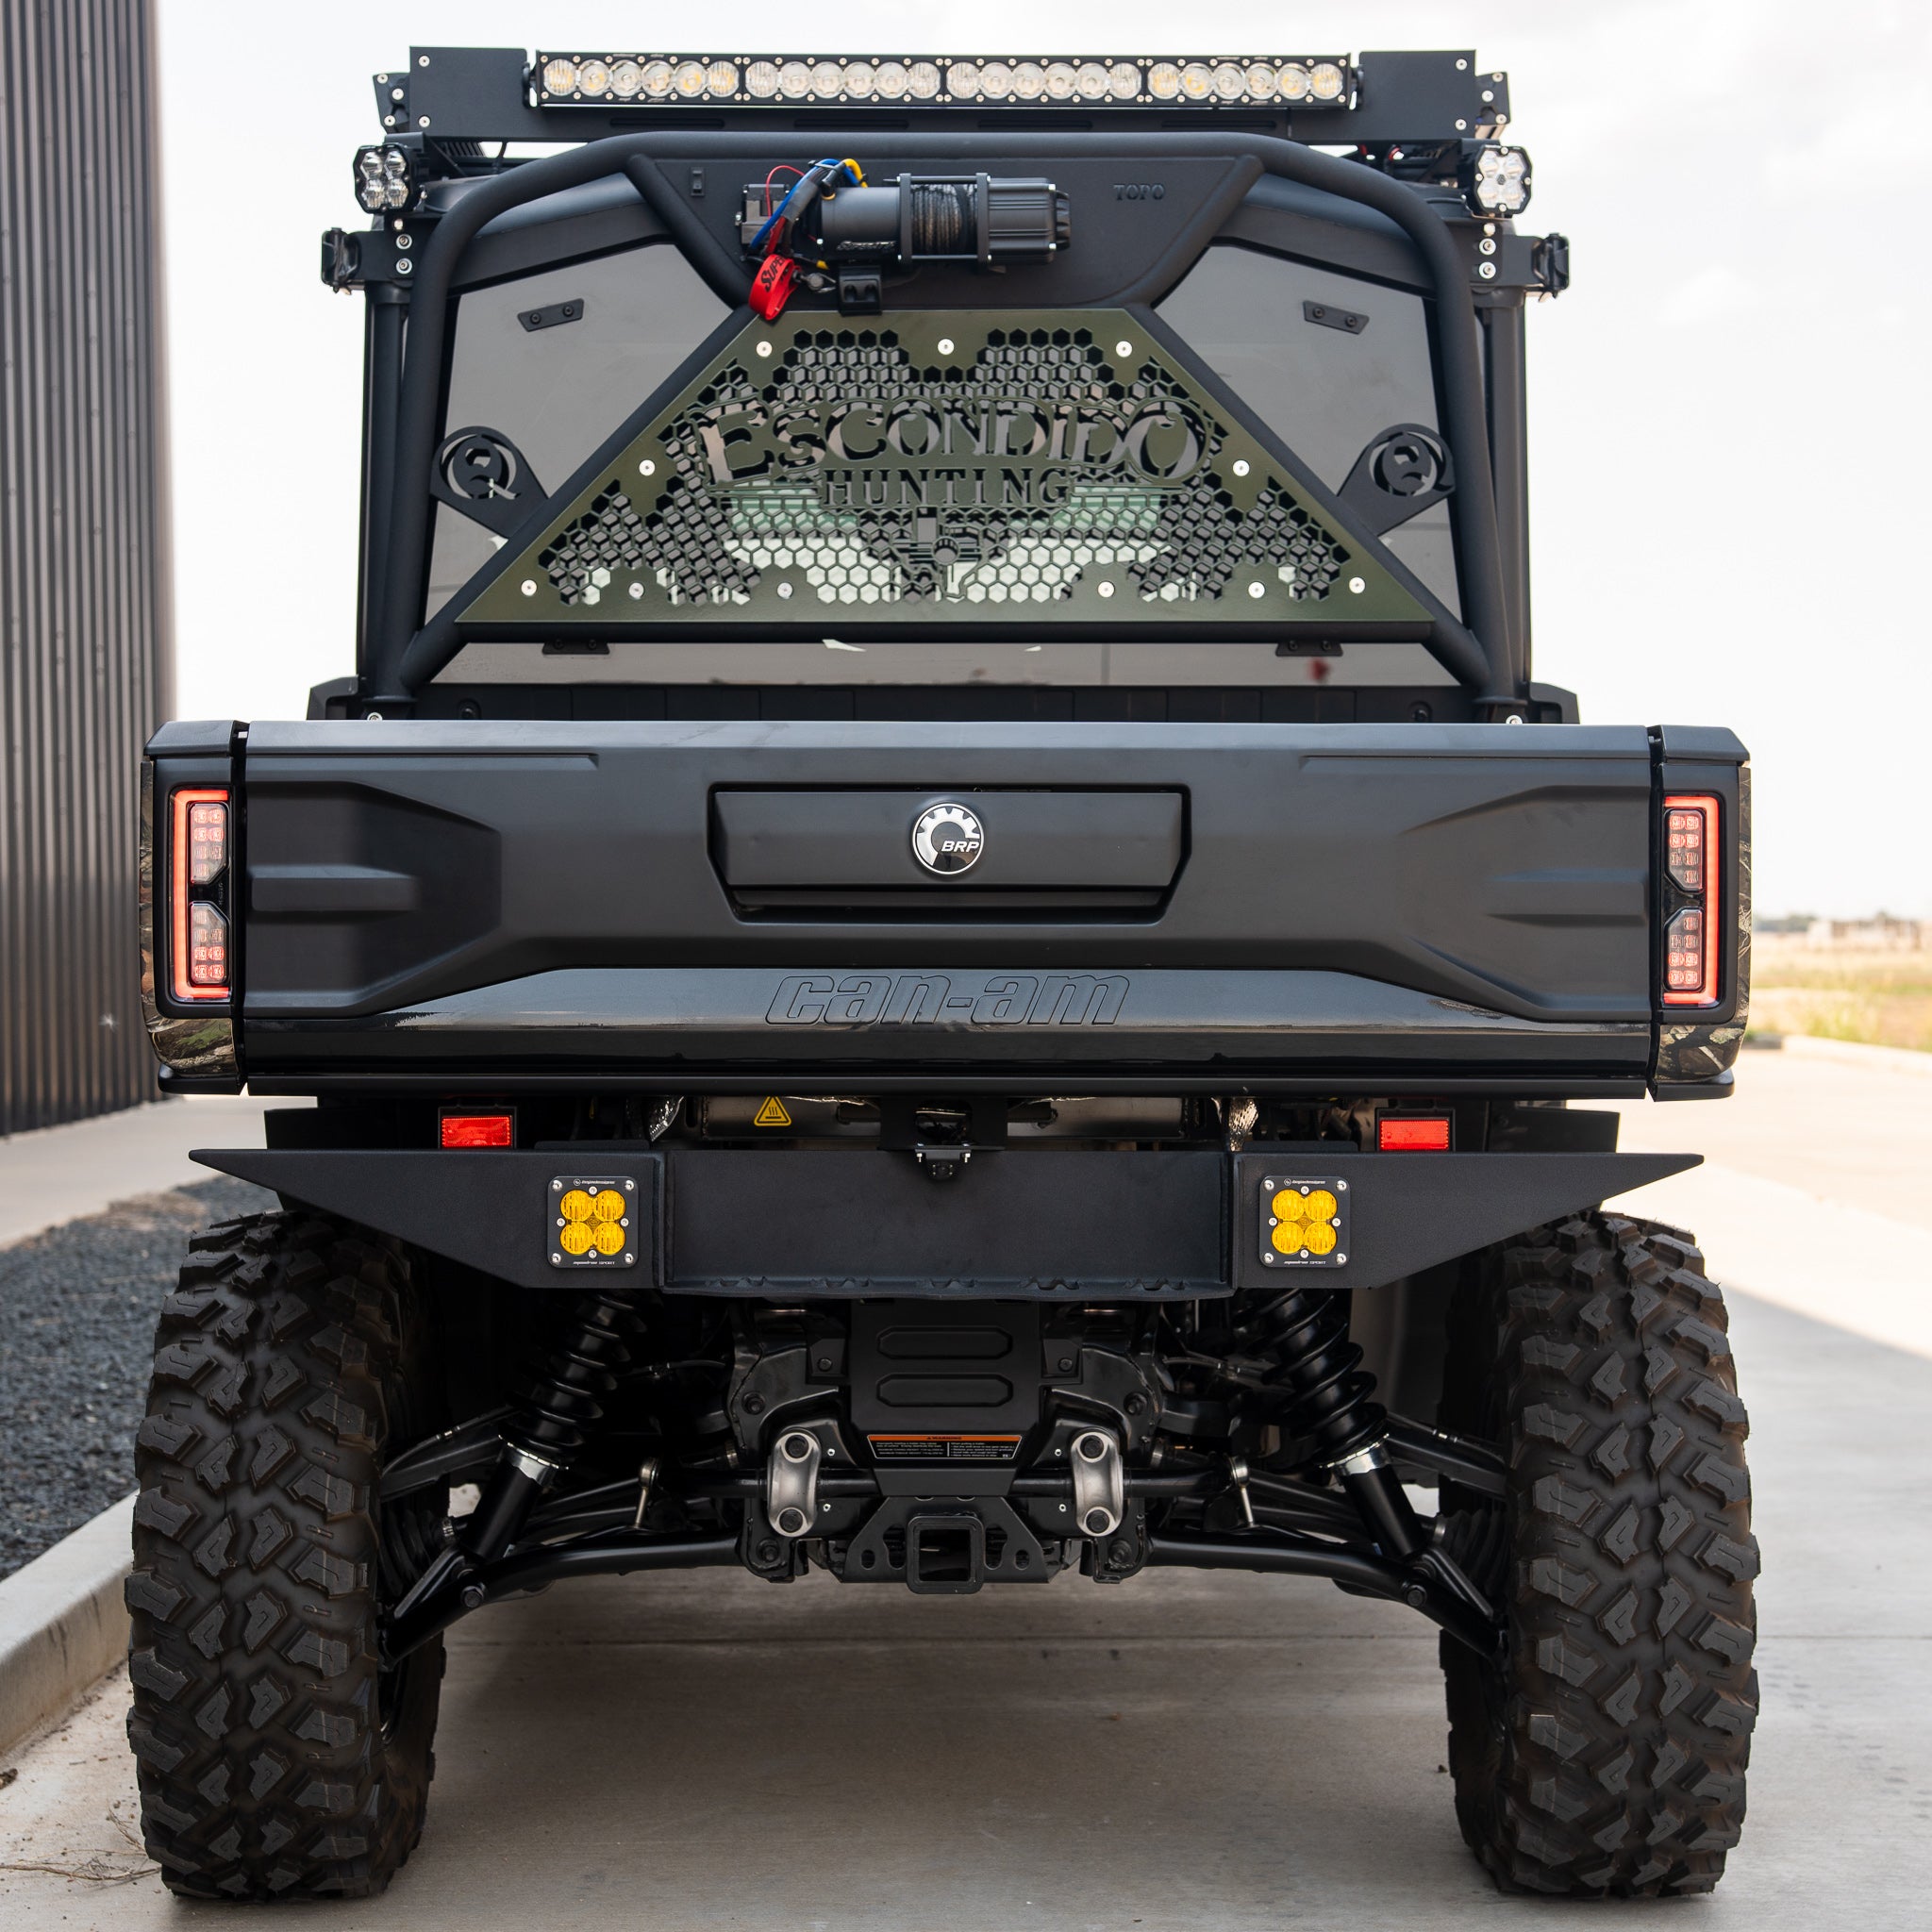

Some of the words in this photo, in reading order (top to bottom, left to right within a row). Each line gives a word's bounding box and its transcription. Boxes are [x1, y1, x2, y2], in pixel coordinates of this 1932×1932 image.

[1112, 183, 1165, 201] TOPO
[693, 400, 1204, 485] ESCONDIDO
[824, 468, 1068, 507] HUNTING
[941, 840, 980, 853] BRP
[765, 974, 1130, 1026] can-am
